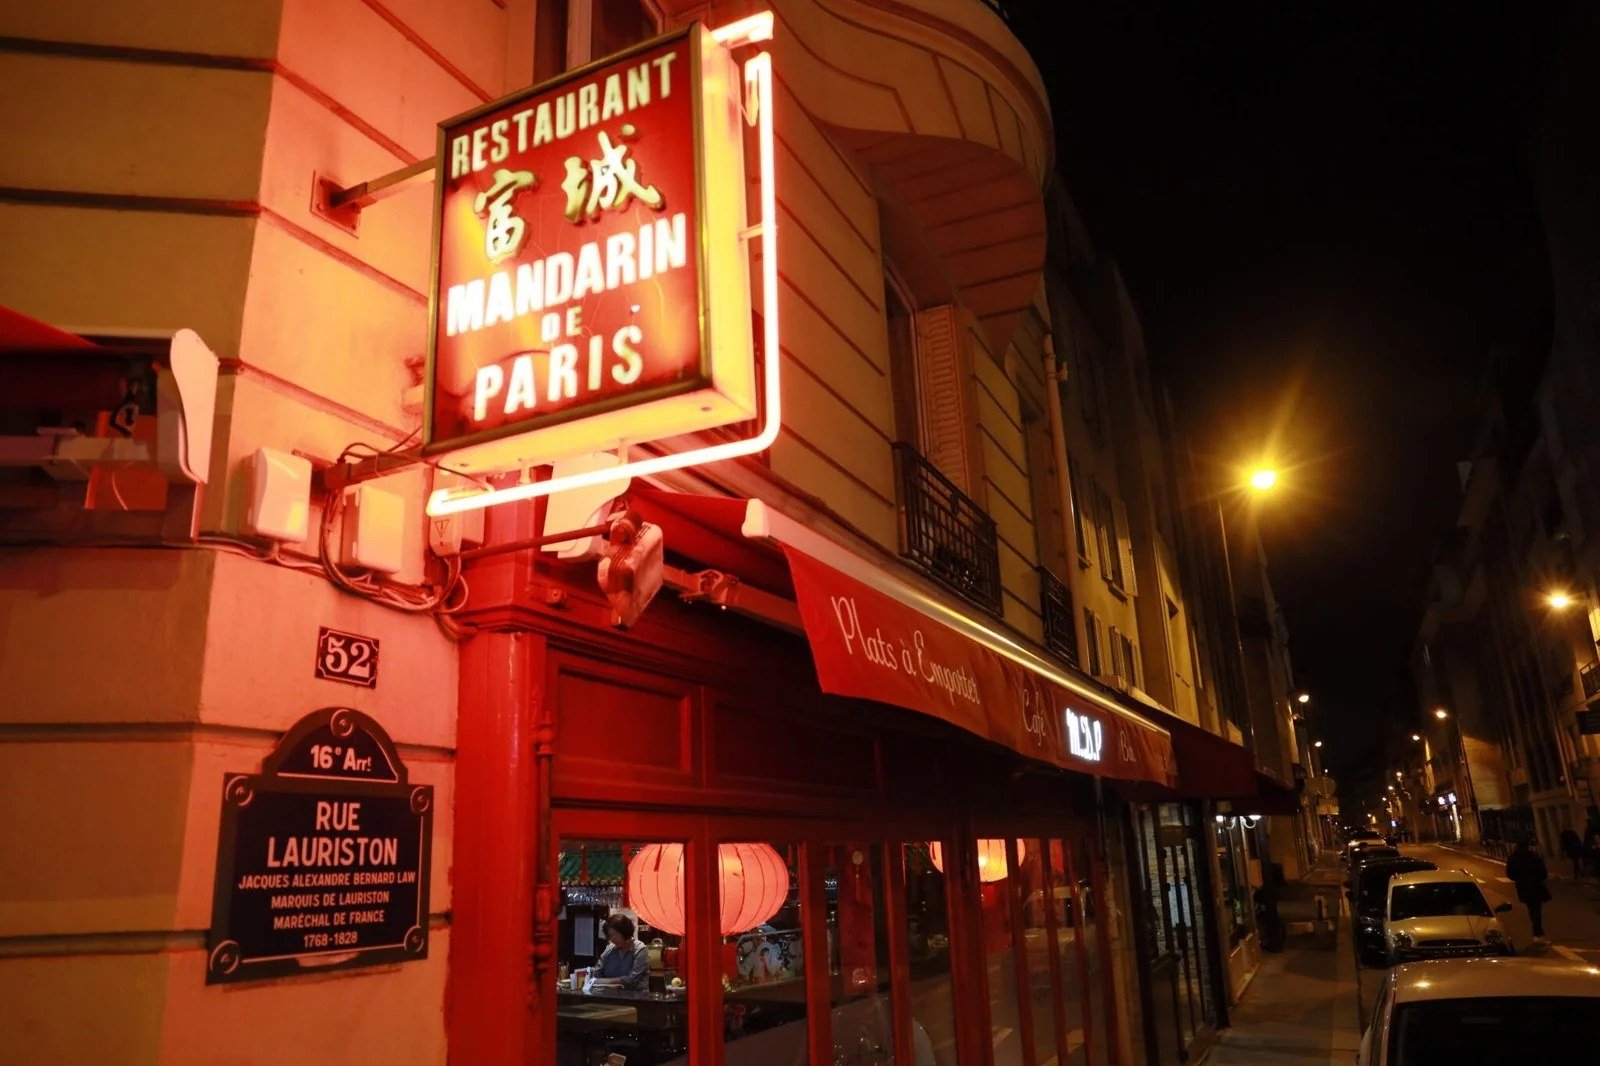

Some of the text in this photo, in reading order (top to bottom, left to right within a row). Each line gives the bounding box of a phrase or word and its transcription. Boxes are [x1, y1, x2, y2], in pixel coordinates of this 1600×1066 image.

[451, 52, 677, 179] RESTAURANT
[446, 213, 686, 337] MANDARIN
[541, 306, 583, 342] DE
[473, 325, 643, 421] PARIS
[831, 596, 897, 670] Plats
[325, 636, 371, 679] 52
[1022, 688, 1046, 746] Café
[315, 801, 361, 831] RUE
[267, 836, 398, 868] LAURISTON
[238, 871, 416, 890] JACQUES ALEXANDRE BERNARD LAW
[271, 891, 390, 909] MARQUIS DE LAURISTON
[273, 910, 385, 930] MARÉCHAL DE FRANCE
[303, 931, 358, 948] 1768-1828
